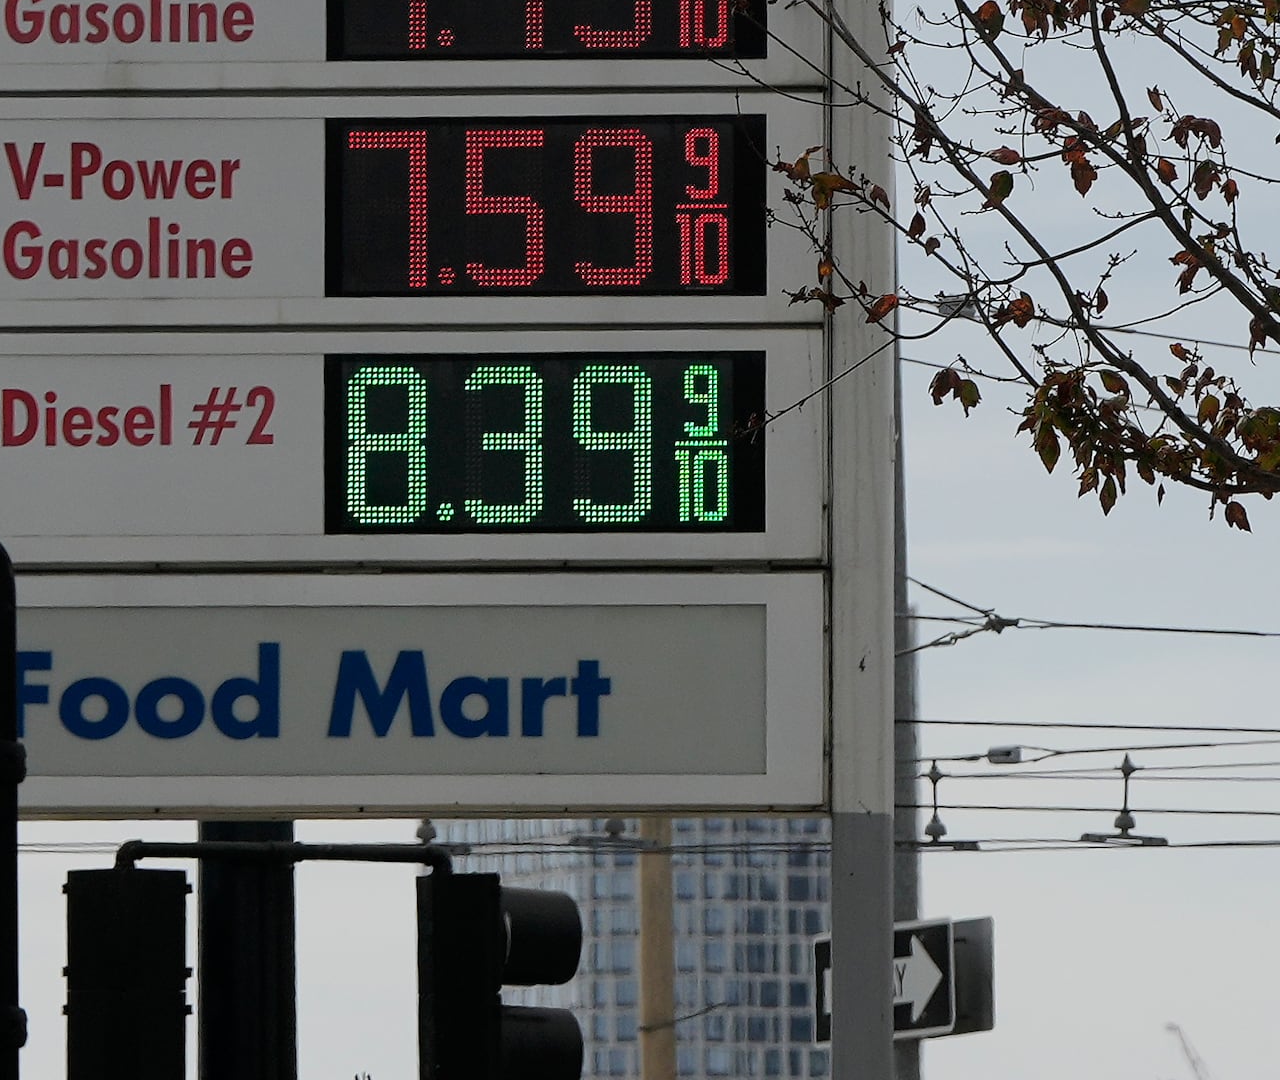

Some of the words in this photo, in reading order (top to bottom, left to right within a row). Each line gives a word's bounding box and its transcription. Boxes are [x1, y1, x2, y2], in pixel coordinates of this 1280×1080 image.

[5, 142, 241, 201] V-Power
[348, 128, 654, 287] 7.59
[3, 218, 254, 280] Gasoline
[2, 384, 174, 447] Diesel
[188, 386, 276, 446] #2
[347, 365, 653, 524] 8.39
[17, 643, 280, 739] Food
[328, 650, 611, 737] Mart
